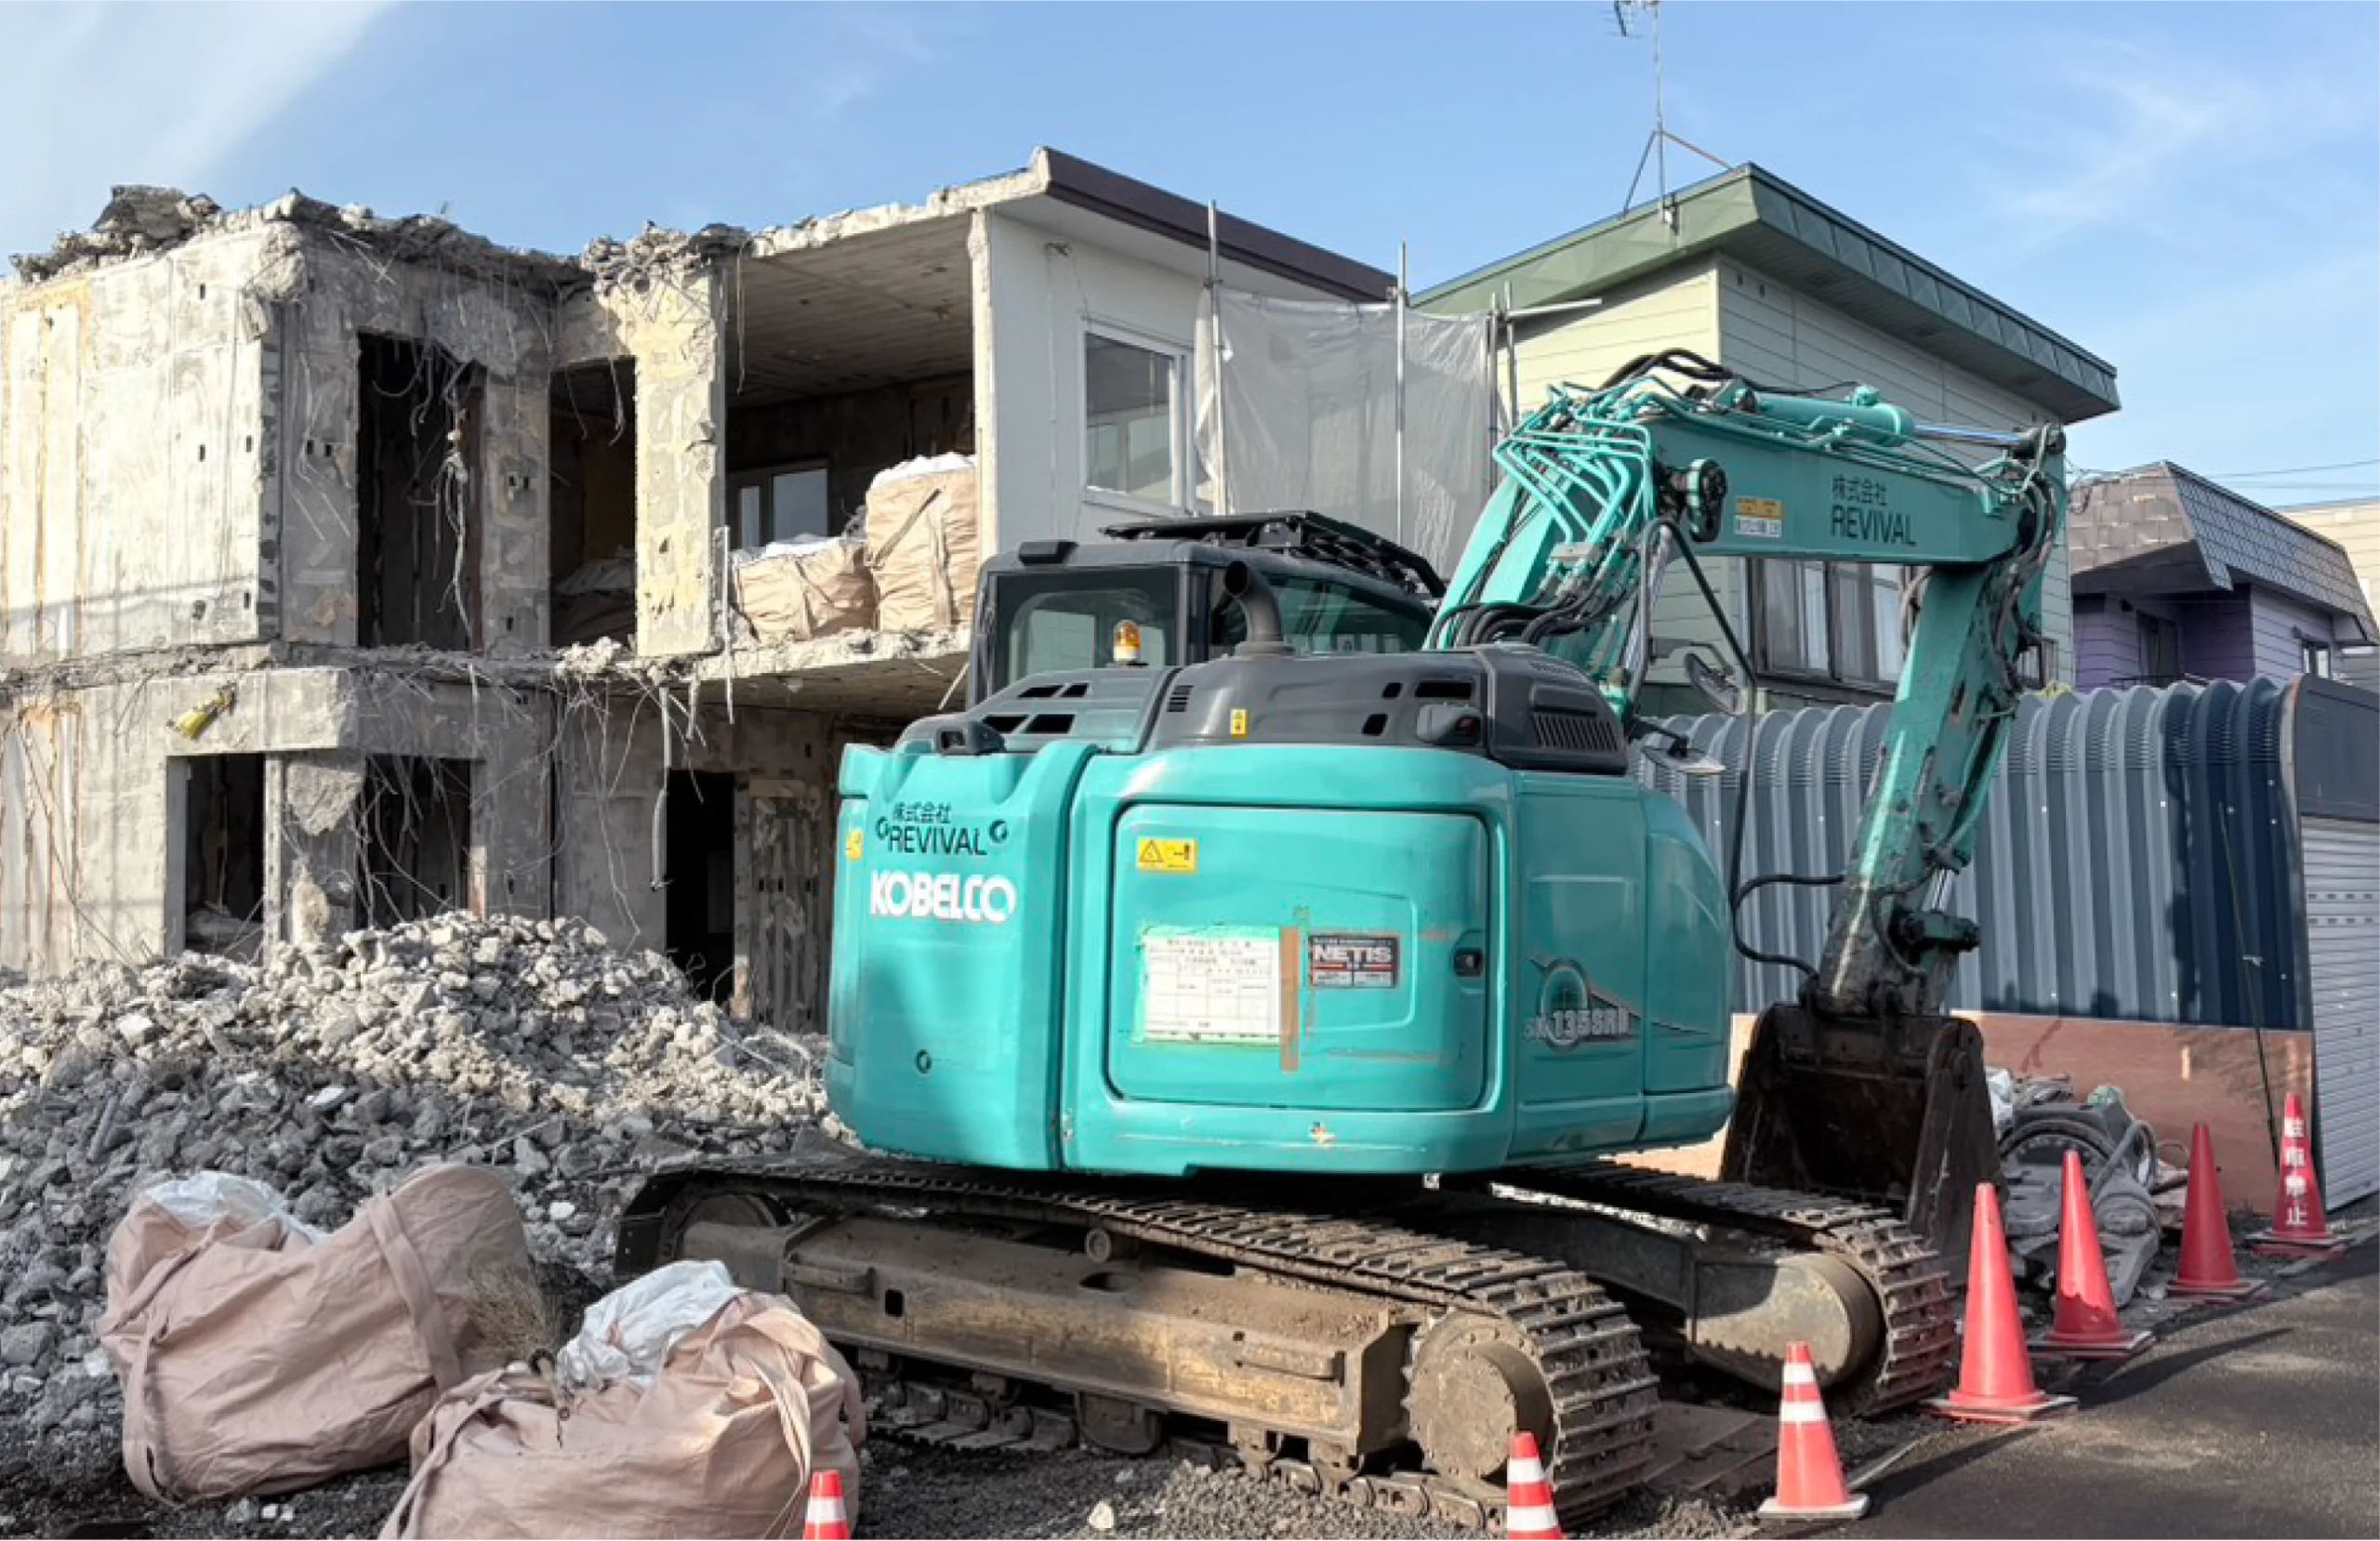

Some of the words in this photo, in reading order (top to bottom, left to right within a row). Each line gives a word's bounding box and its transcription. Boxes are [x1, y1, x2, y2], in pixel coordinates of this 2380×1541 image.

[1831, 474, 1887, 506] 株式会社
[1831, 505, 1916, 546] REVIVAL
[893, 801, 951, 823] 株式会社
[888, 825, 987, 855] REVIVAL
[871, 870, 1016, 922] KOBELCO
[1315, 944, 1392, 964] NETIS
